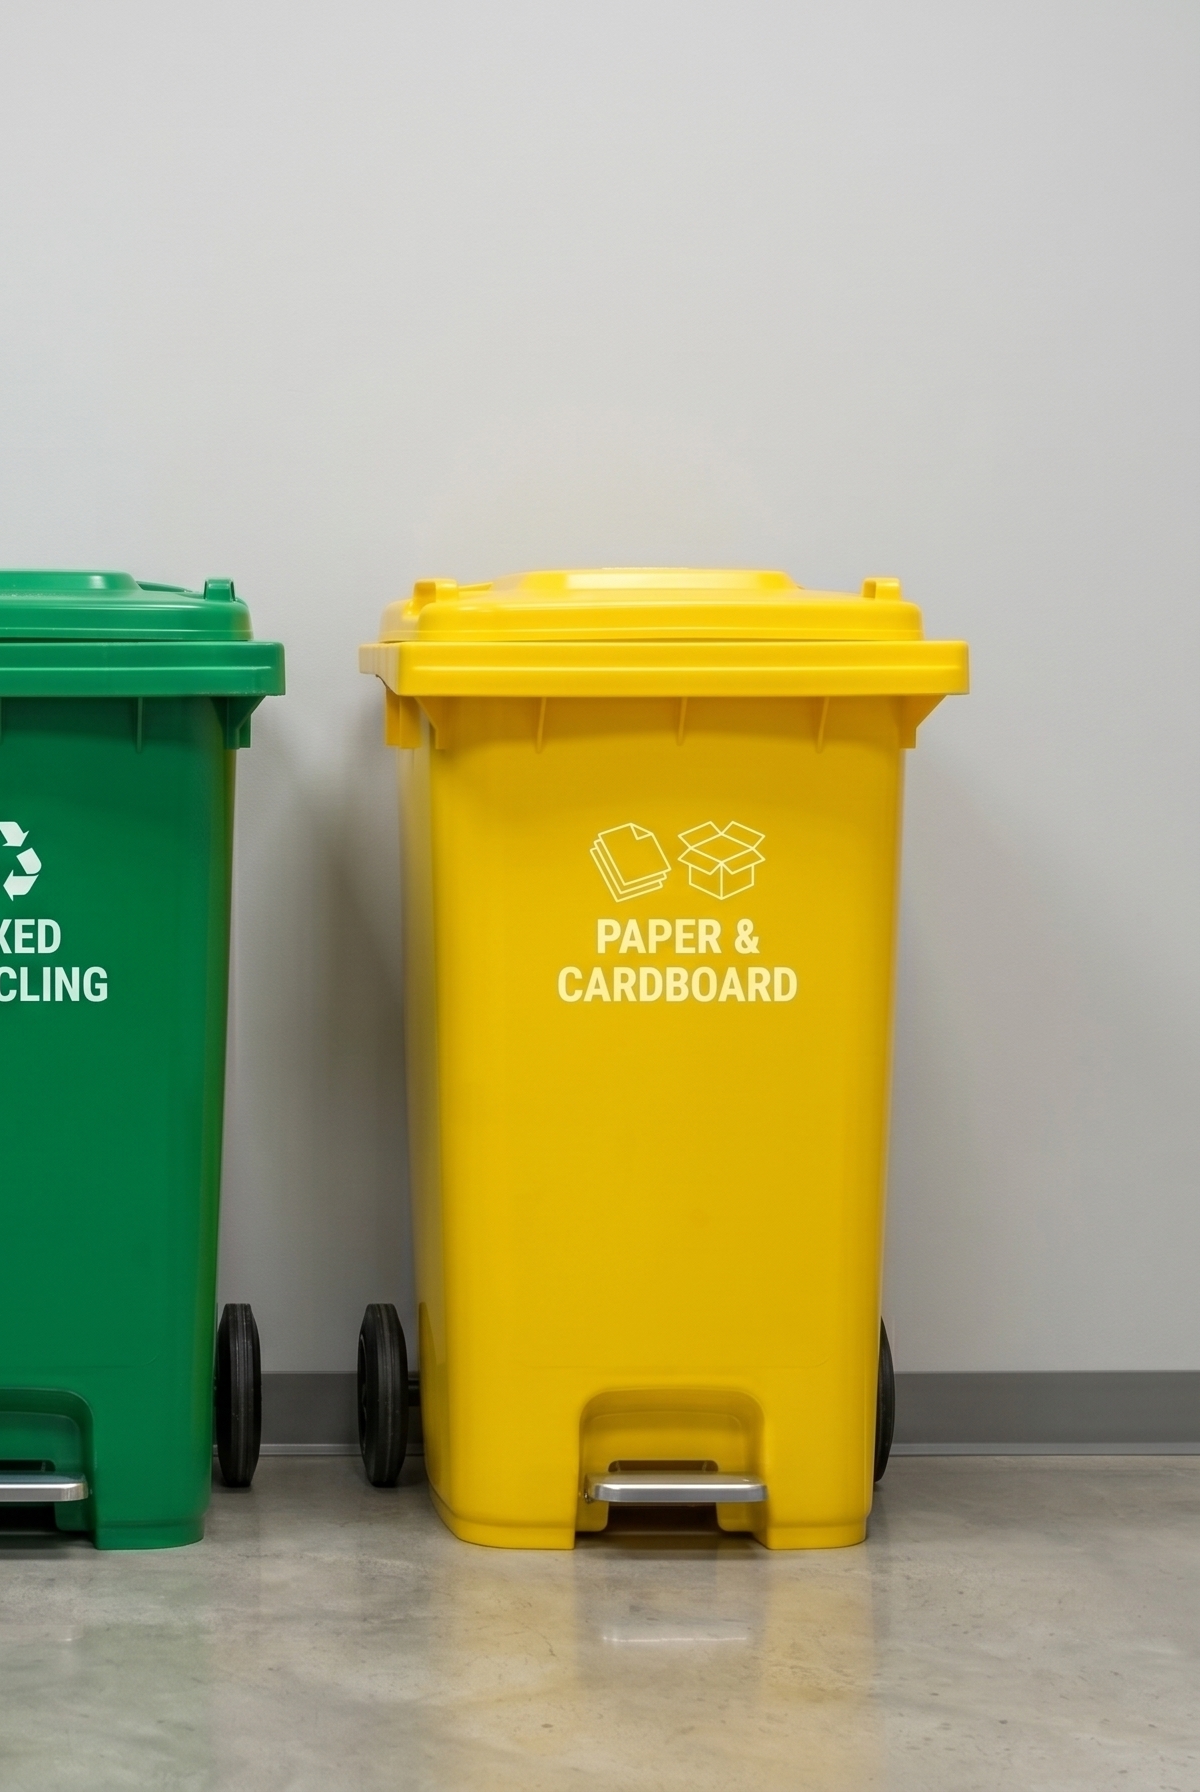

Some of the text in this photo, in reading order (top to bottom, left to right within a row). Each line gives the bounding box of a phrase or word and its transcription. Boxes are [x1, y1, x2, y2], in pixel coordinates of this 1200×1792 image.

[597, 919, 759, 954] PAPER &
[558, 966, 797, 1002] CARDBOARD
